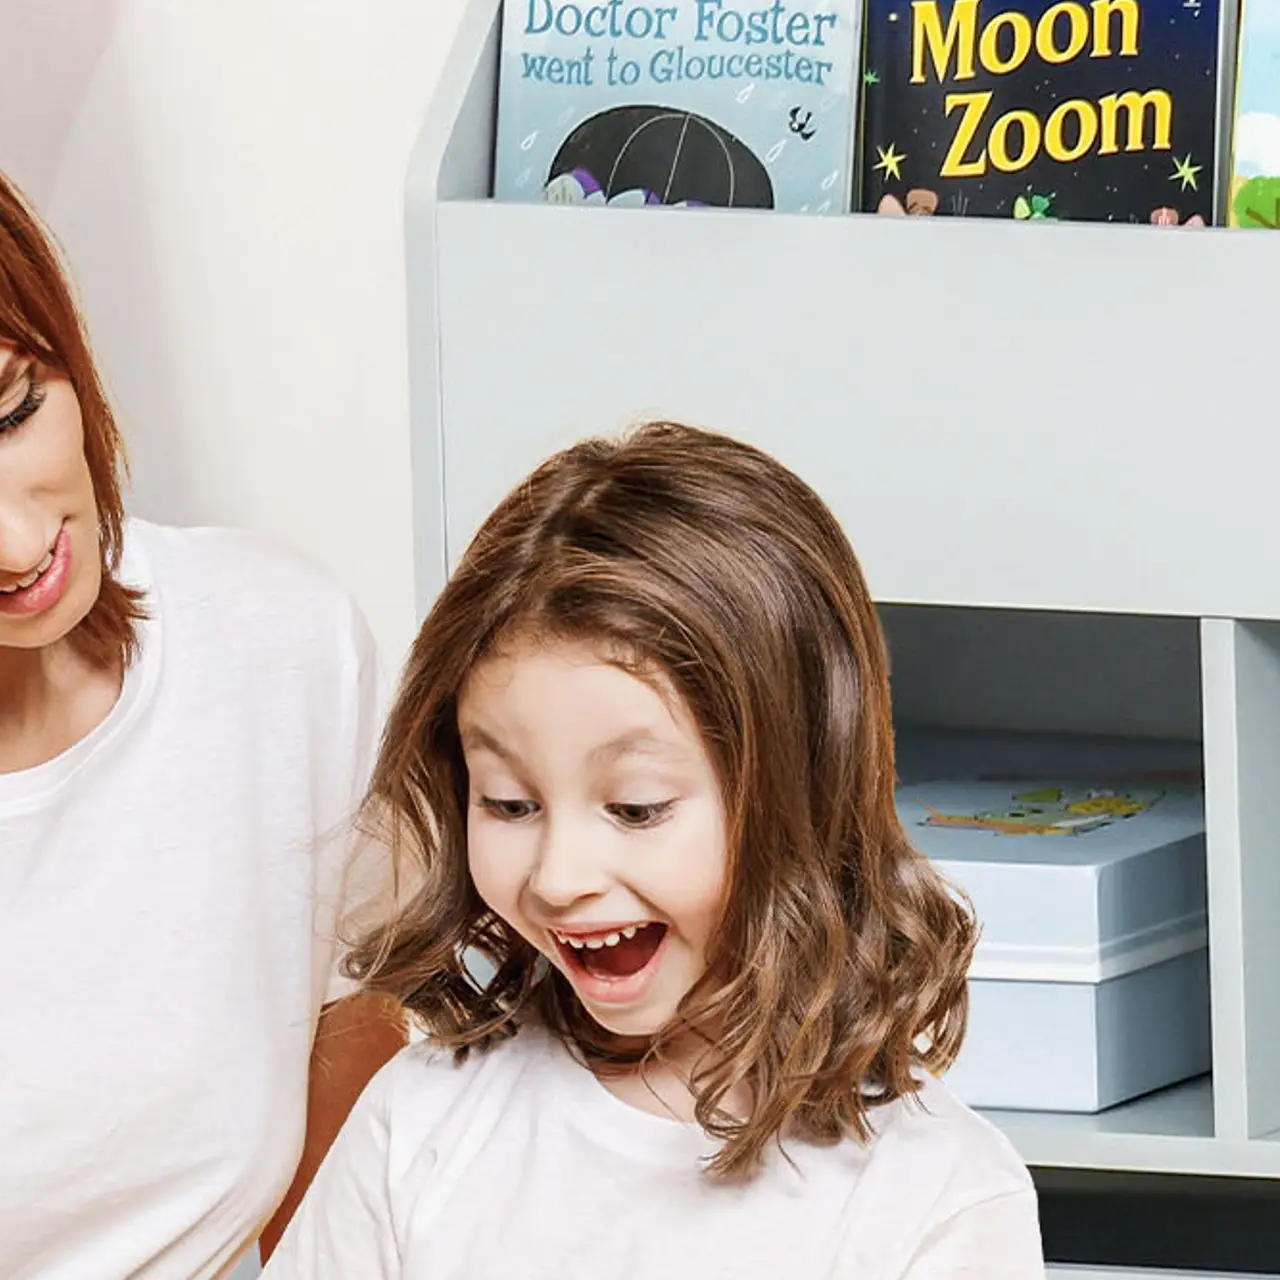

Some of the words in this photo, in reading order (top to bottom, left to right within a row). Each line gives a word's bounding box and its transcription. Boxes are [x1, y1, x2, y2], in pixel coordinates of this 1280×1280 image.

[521, 46, 594, 86] went
[607, 47, 641, 86] to
[649, 46, 832, 85] Gloucester
[939, 88, 1174, 178] Zoom
